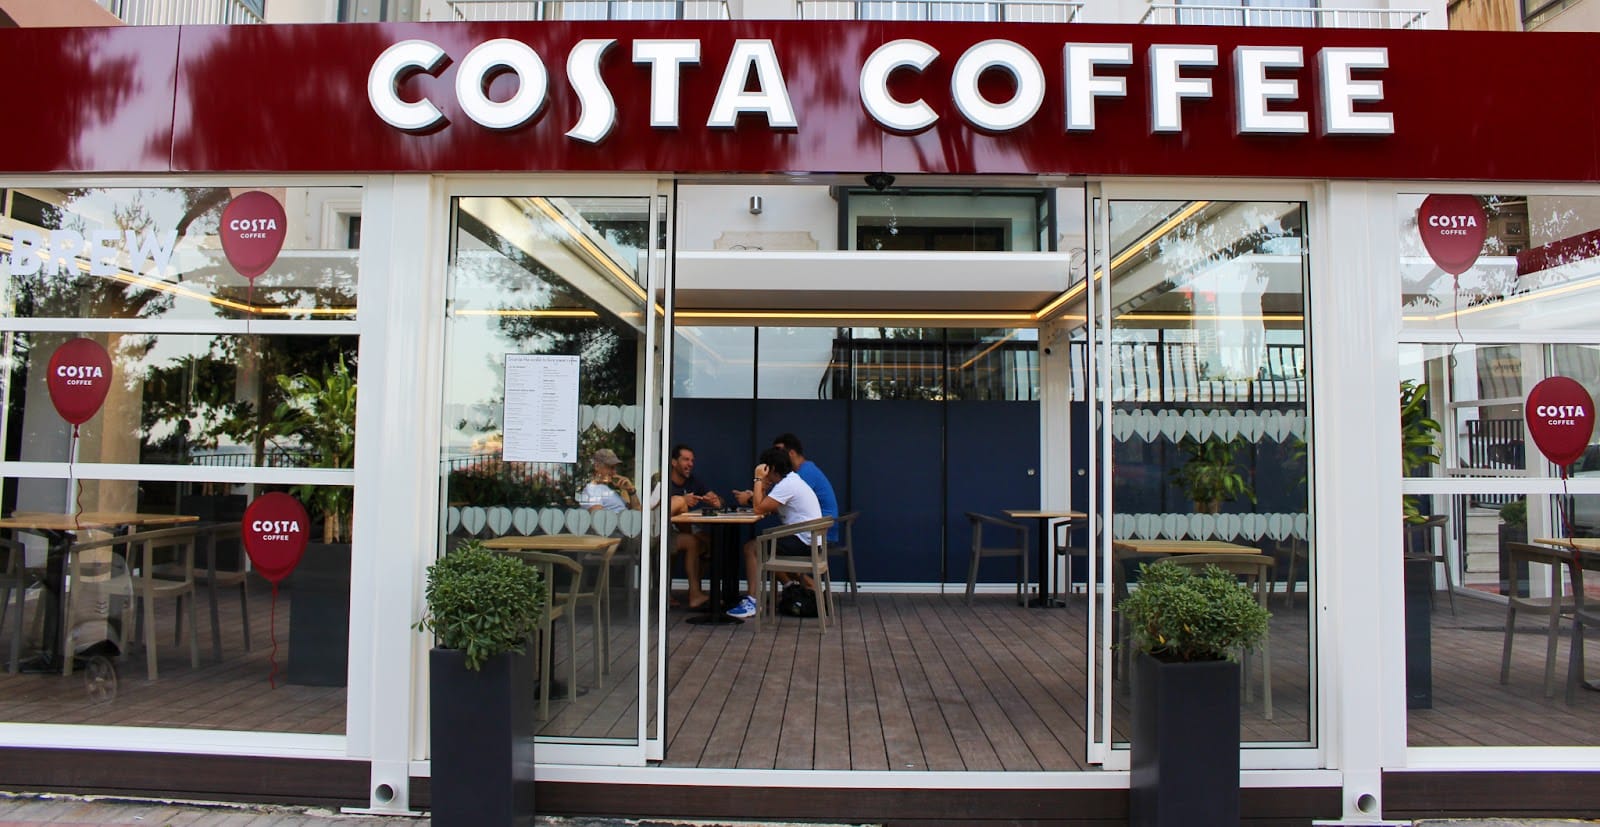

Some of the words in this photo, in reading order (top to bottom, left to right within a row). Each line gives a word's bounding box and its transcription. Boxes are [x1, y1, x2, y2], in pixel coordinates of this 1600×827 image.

[367, 38, 798, 143] COSTA
[859, 38, 1395, 134] COFFEE
[230, 218, 277, 232] COSTA
[1429, 215, 1477, 228] COSTA
[9, 229, 178, 276] BREW
[57, 365, 103, 379] COSTA
[1537, 405, 1585, 418] COSTA
[252, 520, 299, 534] COSTA
